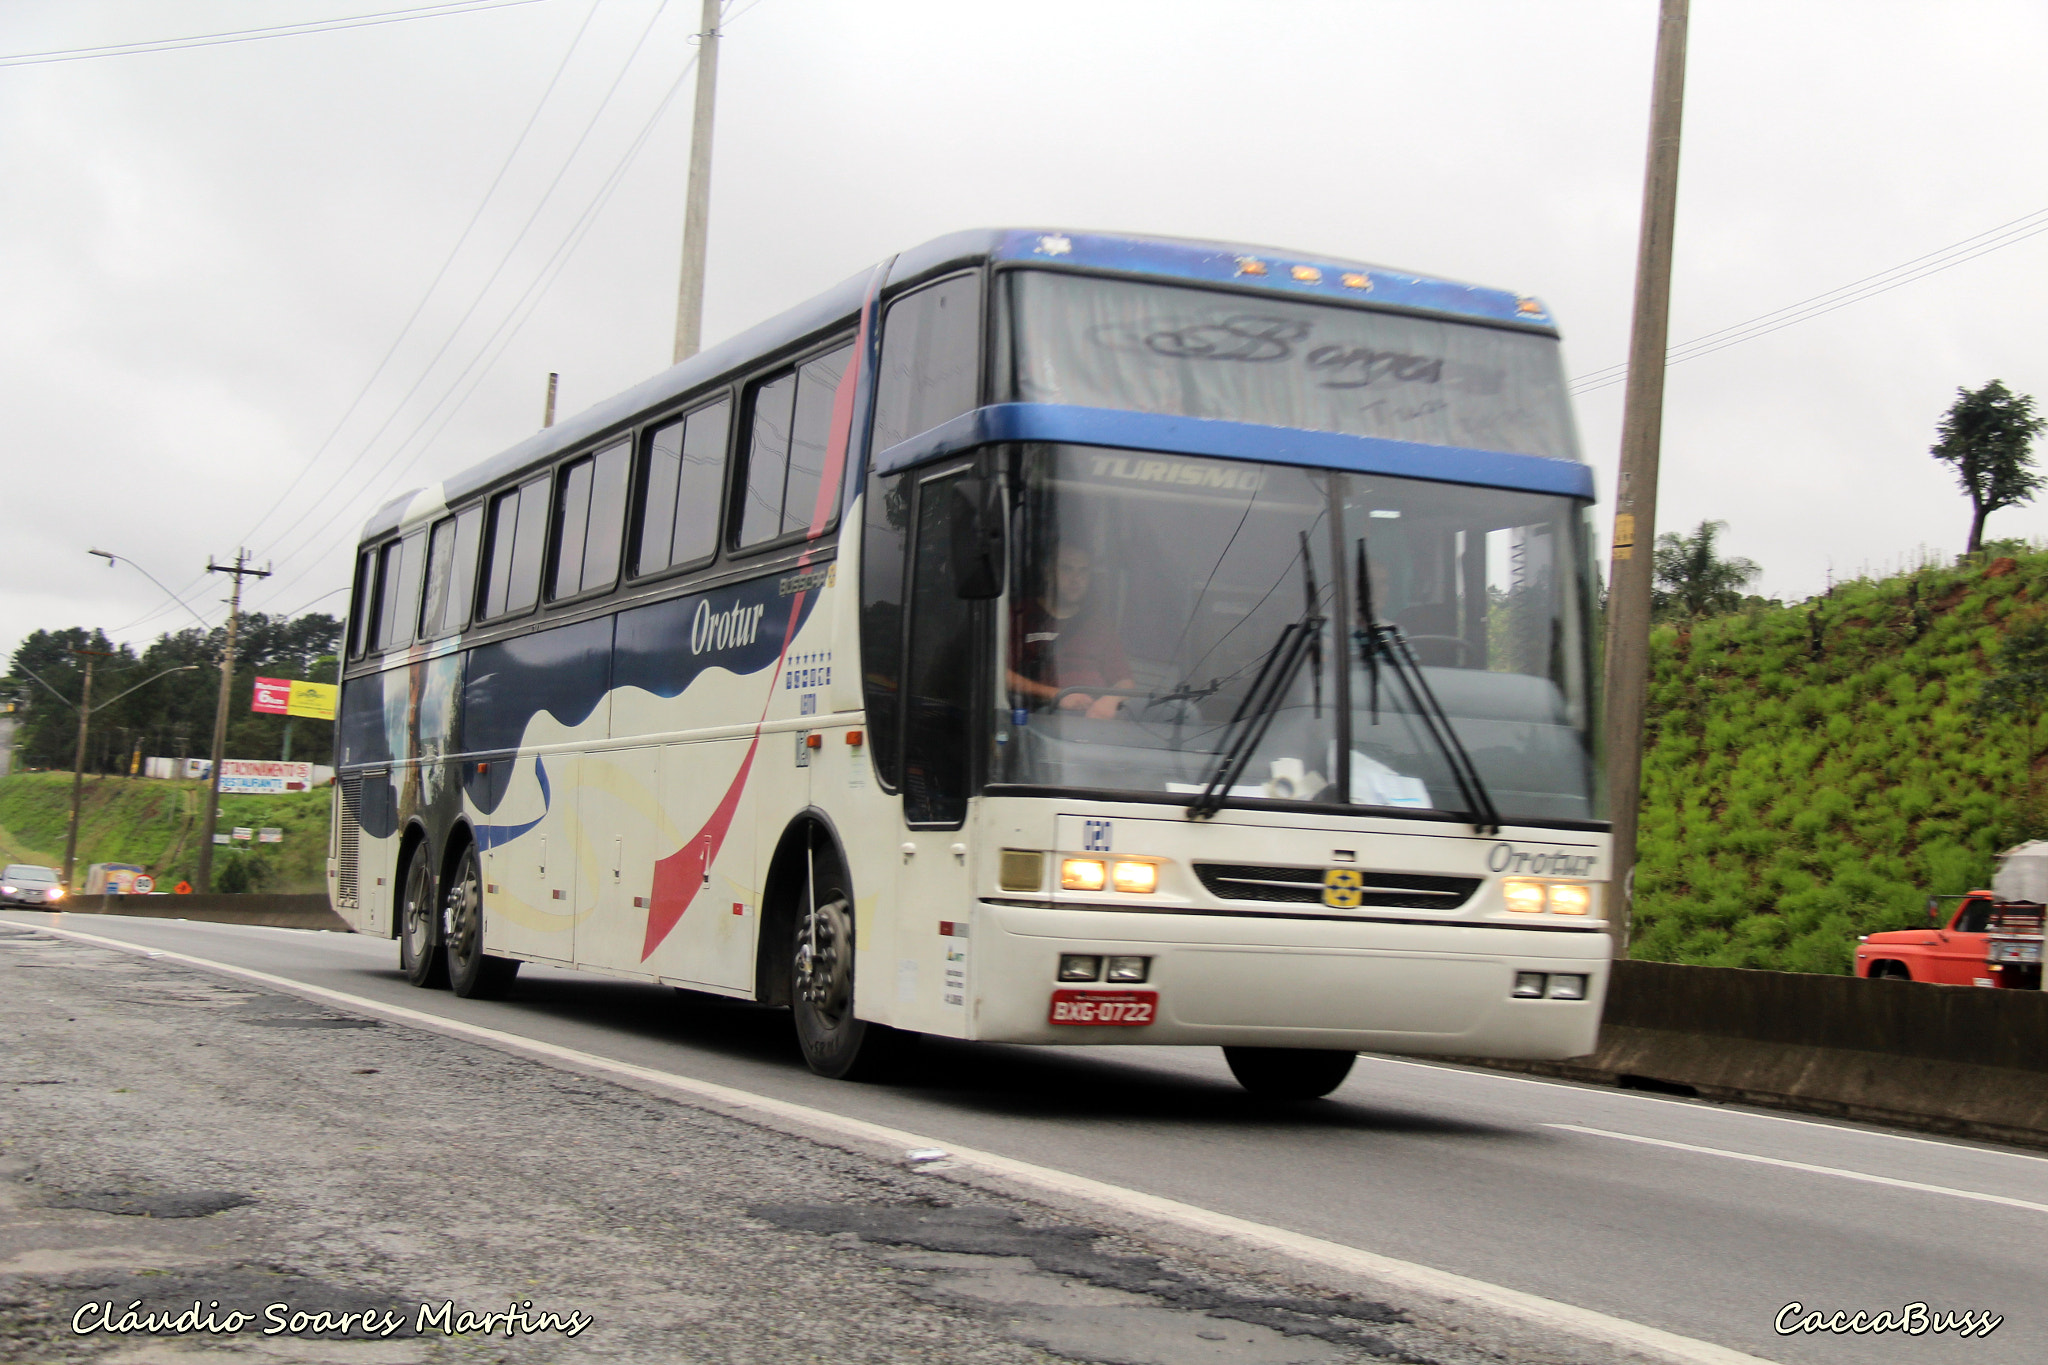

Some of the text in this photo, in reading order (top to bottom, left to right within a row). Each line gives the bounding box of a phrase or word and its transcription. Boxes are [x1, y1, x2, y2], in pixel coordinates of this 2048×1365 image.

[1090, 454, 1266, 492] TURISMO
[779, 570, 827, 597] BUSSCAR
[691, 599, 764, 655] Orotur
[1487, 842, 1598, 877] Orotur
[1053, 1001, 1153, 1021] BXG-0722
